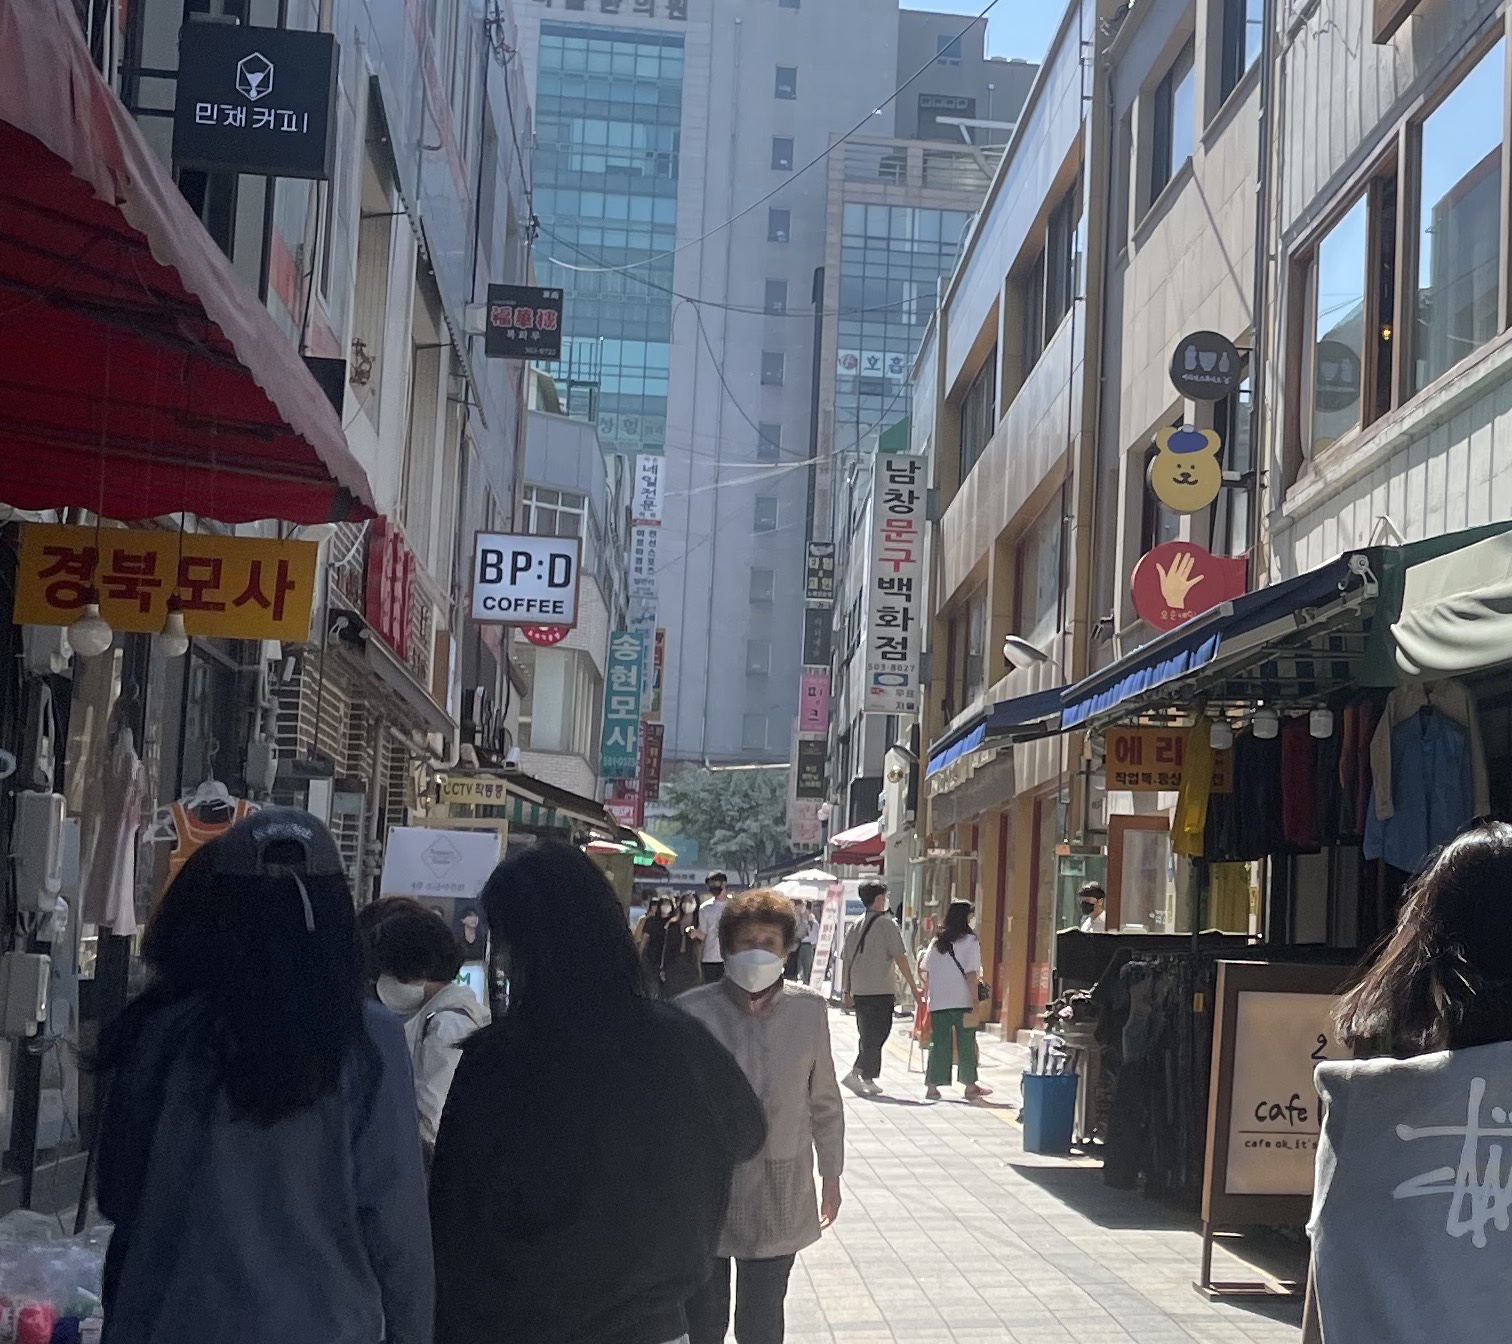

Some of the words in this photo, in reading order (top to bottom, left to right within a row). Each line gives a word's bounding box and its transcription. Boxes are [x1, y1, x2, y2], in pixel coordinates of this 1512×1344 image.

[479, 548, 572, 588] BP:D
[875, 460, 921, 662] 남창문구백화점
[38, 544, 296, 622] 경북모사
[482, 595, 565, 615] COFFEE
[606, 634, 641, 753] 송현모사
[443, 782, 473, 796] CCTV
[1255, 1093, 1308, 1126] cafe
[1244, 1138, 1271, 1148] cafe
